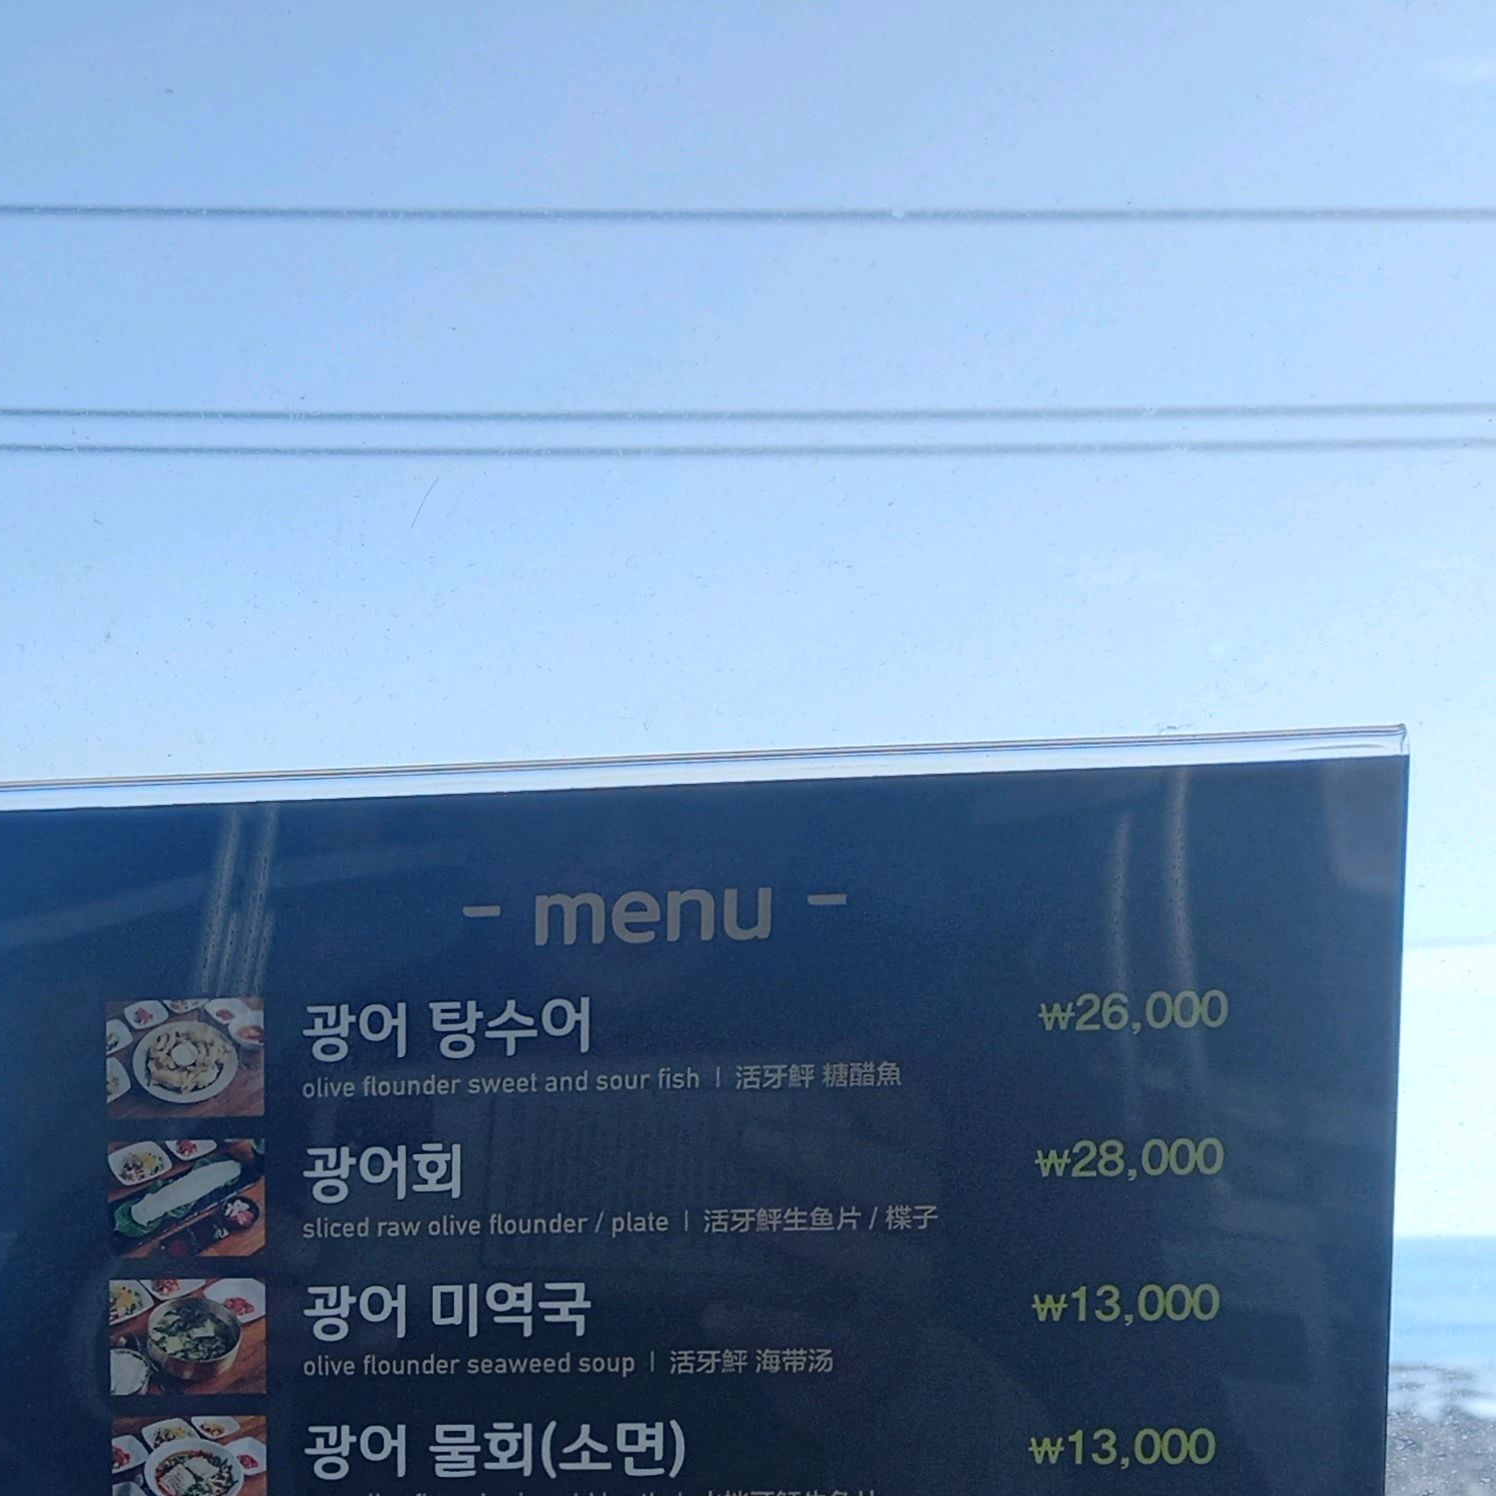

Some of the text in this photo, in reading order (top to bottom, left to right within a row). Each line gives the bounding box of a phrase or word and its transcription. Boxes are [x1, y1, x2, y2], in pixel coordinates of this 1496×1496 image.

[535, 888, 771, 945] menu
[303, 997, 589, 1062] 광어 탕수어
[1038, 989, 1229, 1034] ₩26,000
[303, 1067, 699, 1098] olive flounder sweet and sour fish
[303, 1143, 461, 1203] 광어회
[1035, 1137, 1224, 1181] ₩28,000
[303, 1217, 369, 1238] sliced
[378, 1221, 421, 1236] raw
[428, 1215, 480, 1235] olive
[490, 1213, 588, 1234] flounder
[612, 1212, 668, 1238] plate
[304, 1282, 591, 1341] 광어 미역국
[1032, 1284, 1220, 1326] ₩13,000
[304, 1352, 635, 1377] olive flounder seaweed soup
[756, 1348, 833, 1373] 海带汤
[305, 1420, 685, 1480] 광어 물회(소면)
[1028, 1428, 1216, 1469] ₩13,000
